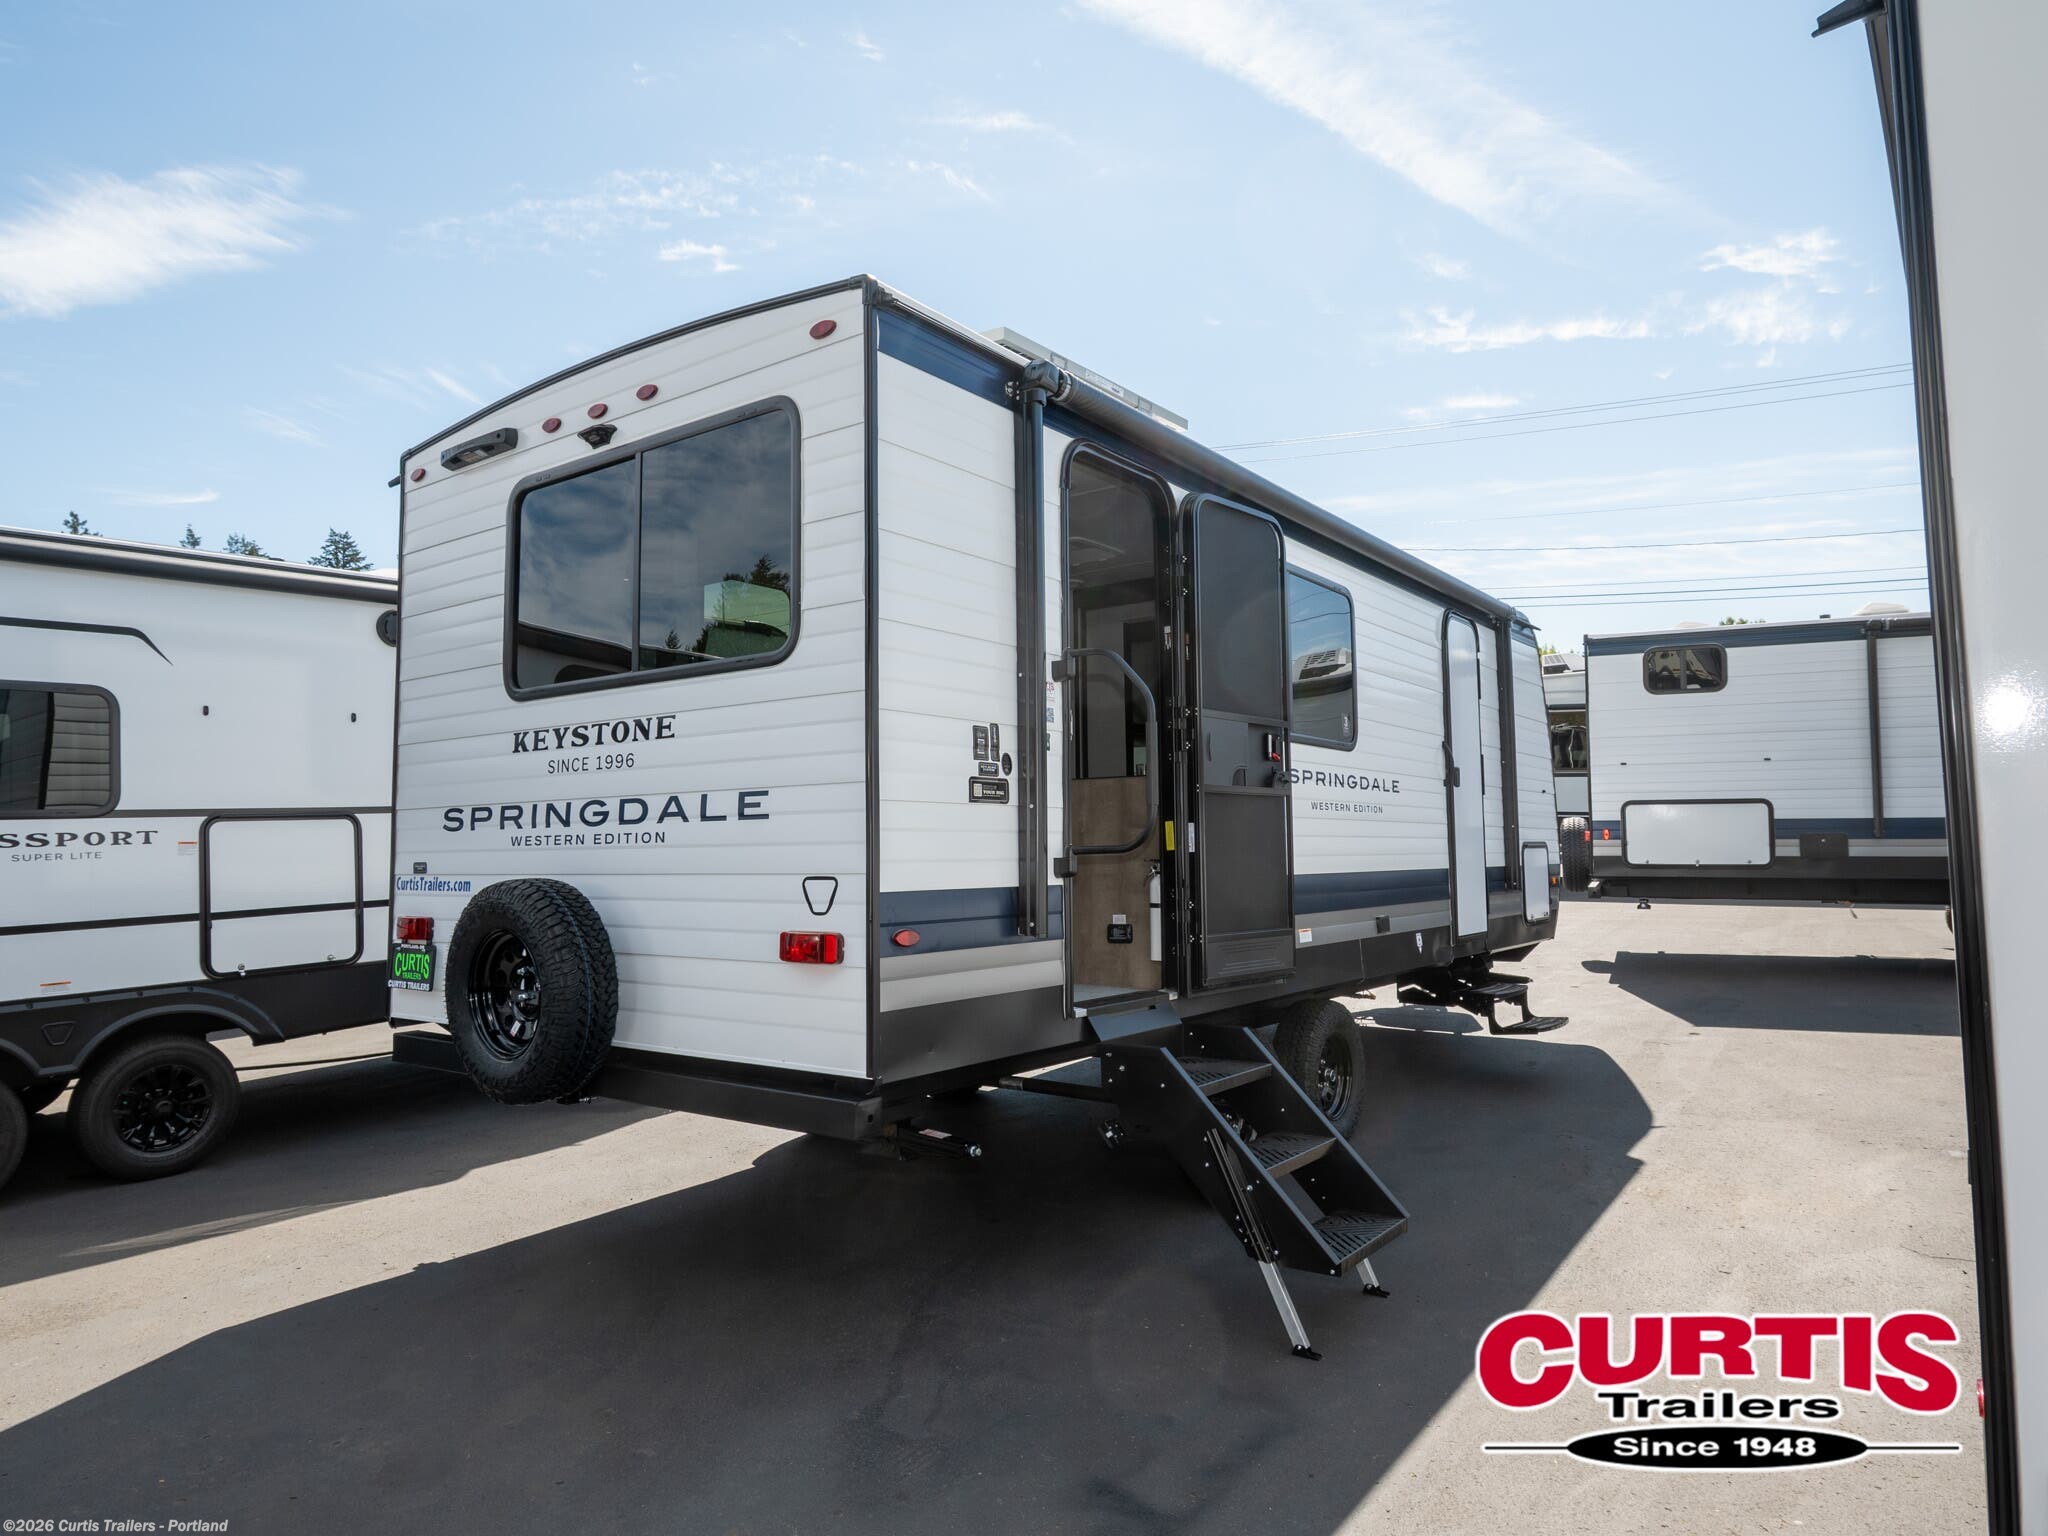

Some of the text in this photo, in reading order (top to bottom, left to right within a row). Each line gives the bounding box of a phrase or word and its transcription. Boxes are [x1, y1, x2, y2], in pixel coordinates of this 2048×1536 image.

[512, 714, 676, 753] KEYSTONE
[547, 753, 635, 774] SINCE 1996
[1290, 768, 1400, 793] SPRINGDALE
[442, 790, 770, 832] SPRINGDALE
[1310, 801, 1384, 814] WESTERN EDITION
[510, 831, 667, 847] WESTERN EDITION
[11, 851, 103, 862] SUPER LITE
[396, 876, 472, 892] CurtisTrailers.com
[395, 953, 429, 979] CURTIS
[388, 980, 429, 990] CURTIS TRAILERS
